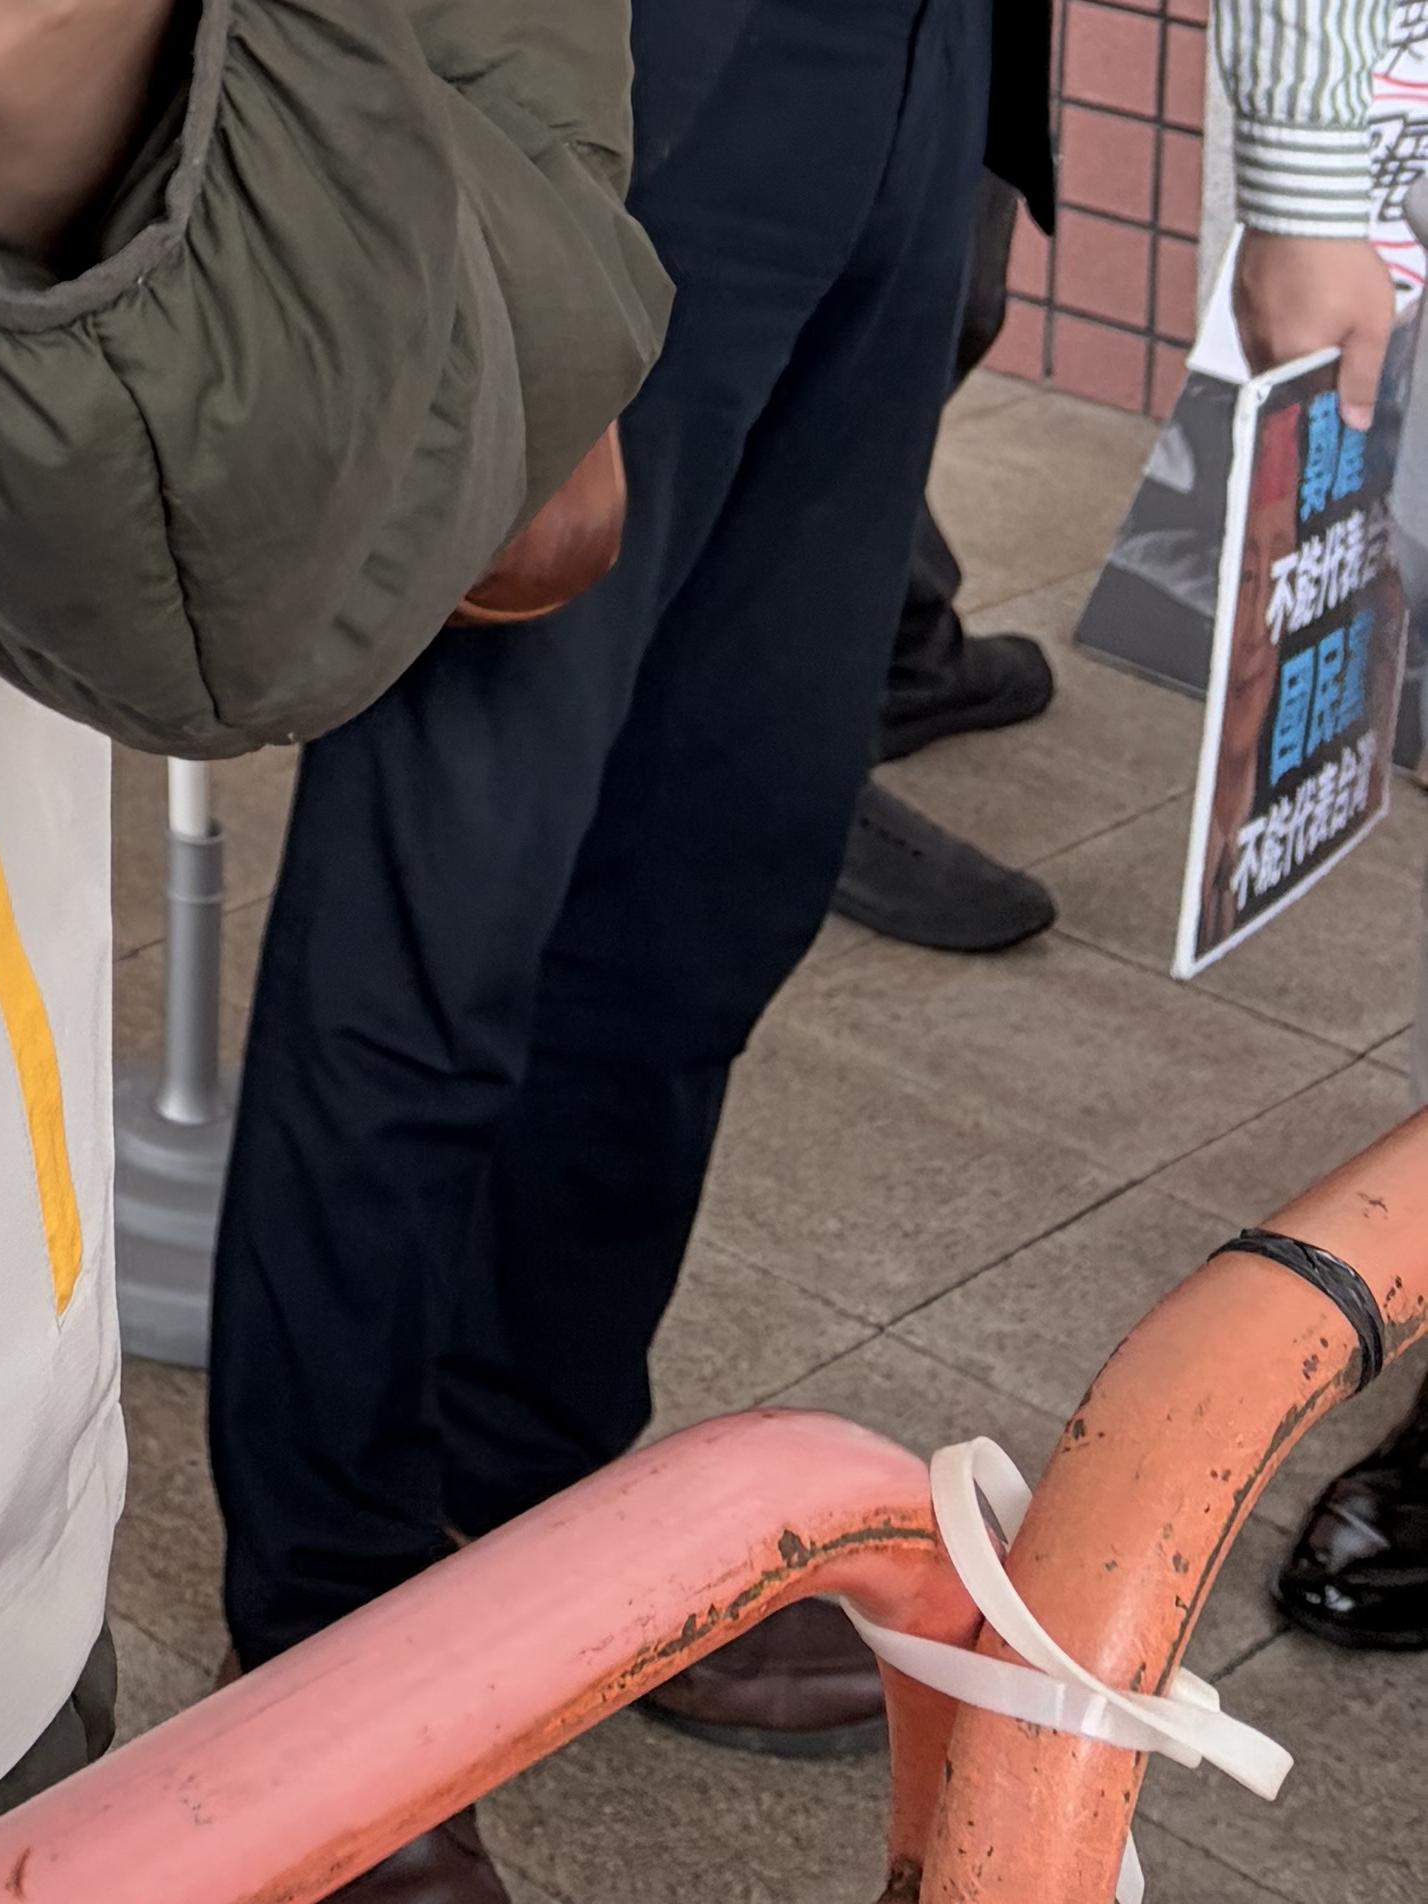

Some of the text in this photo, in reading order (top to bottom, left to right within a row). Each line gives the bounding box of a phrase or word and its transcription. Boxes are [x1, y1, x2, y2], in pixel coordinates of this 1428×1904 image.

[1265, 508, 1384, 646] 不能代表台
